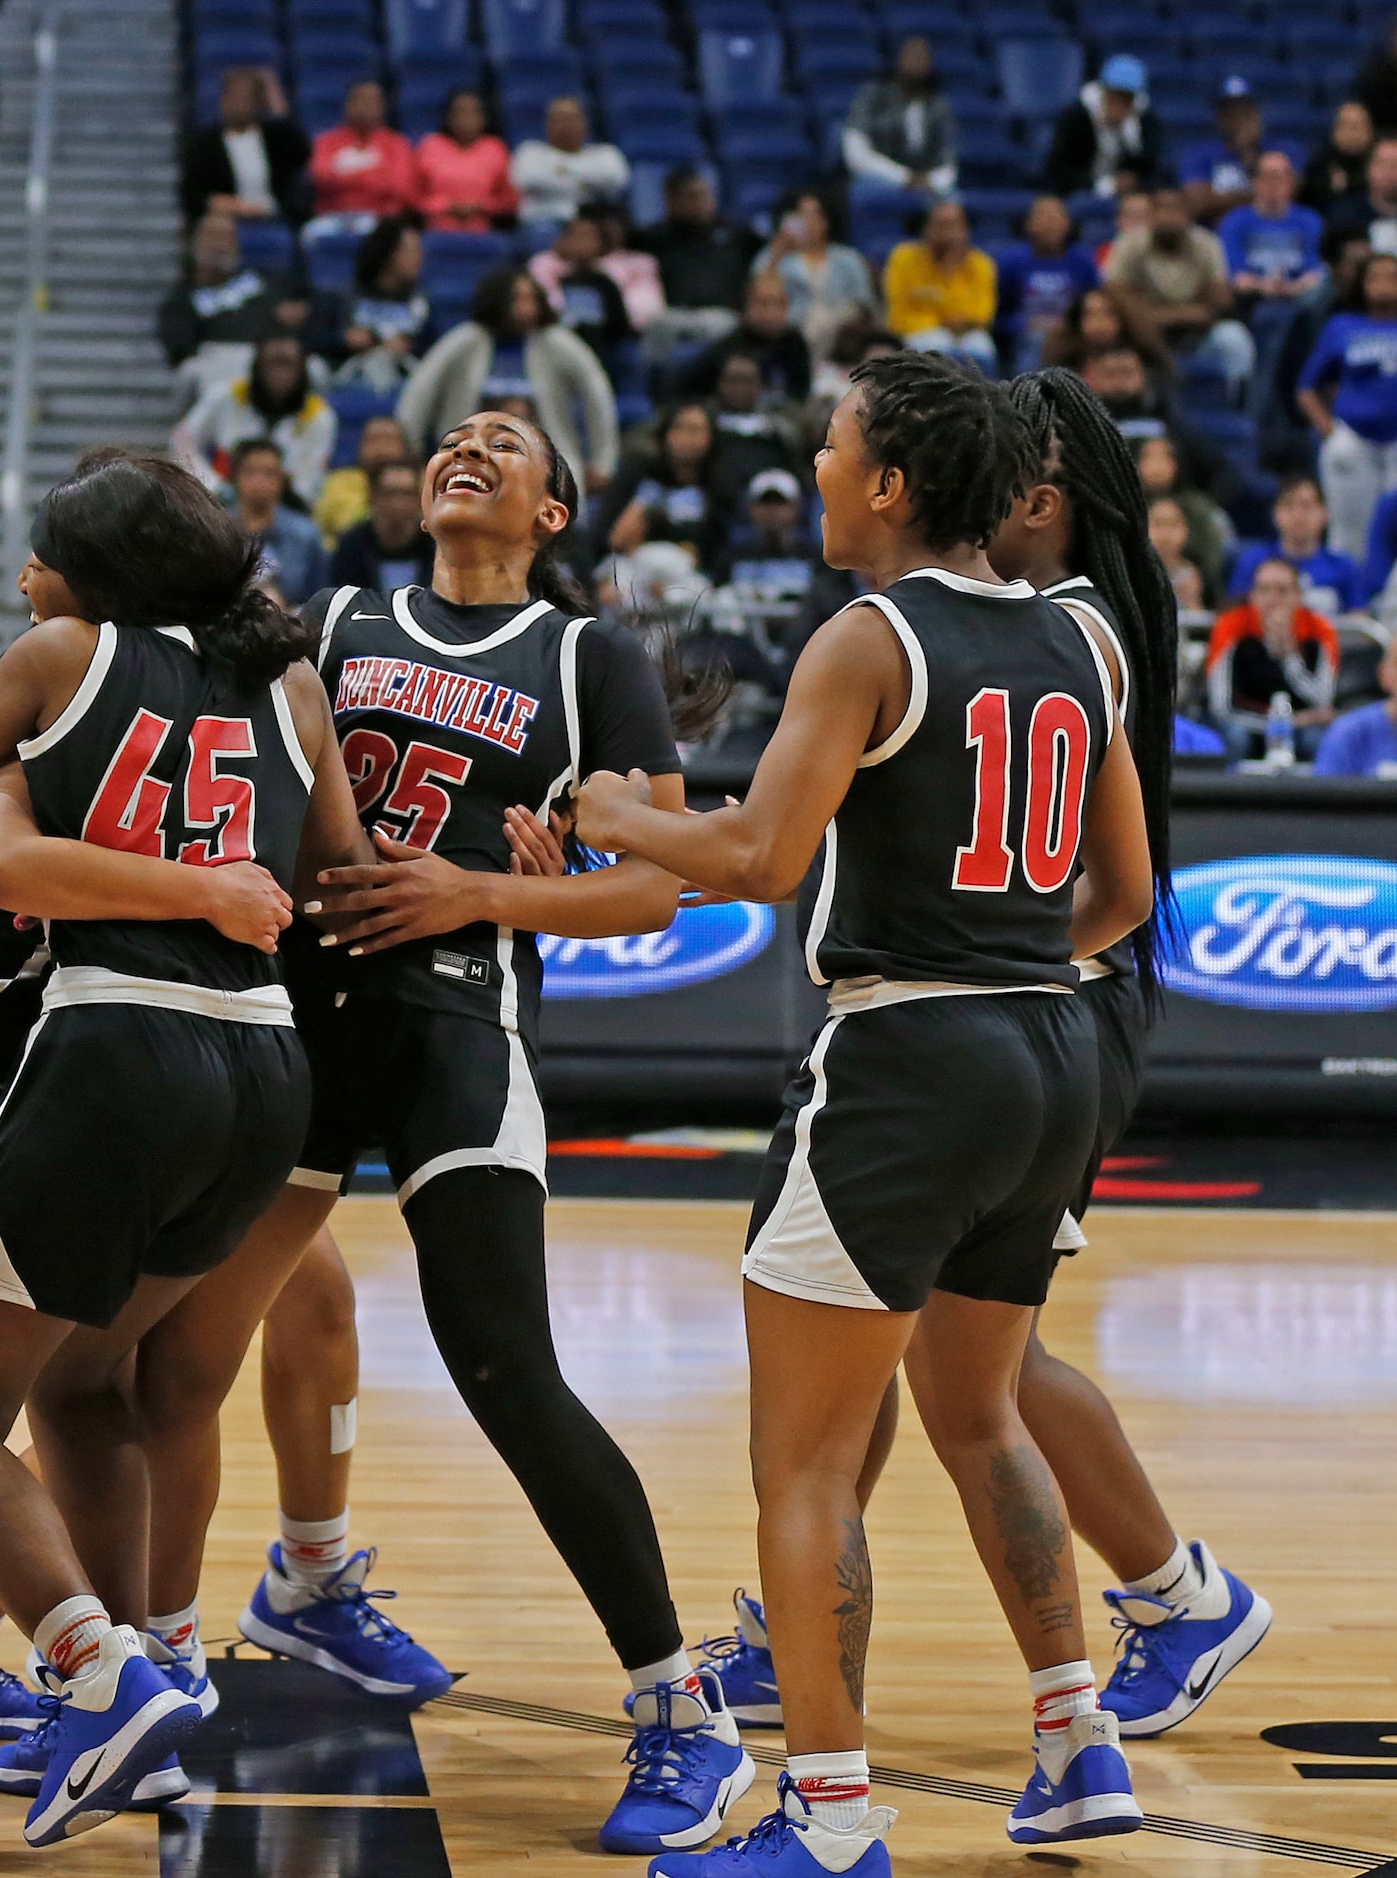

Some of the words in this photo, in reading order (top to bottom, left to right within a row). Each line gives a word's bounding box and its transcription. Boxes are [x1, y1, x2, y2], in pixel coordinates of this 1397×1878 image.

[333, 655, 541, 757] DUNCANVILLE
[82, 707, 257, 866] 45
[341, 728, 473, 864] 25
[951, 687, 1091, 894] 10
[470, 964, 483, 978] M
